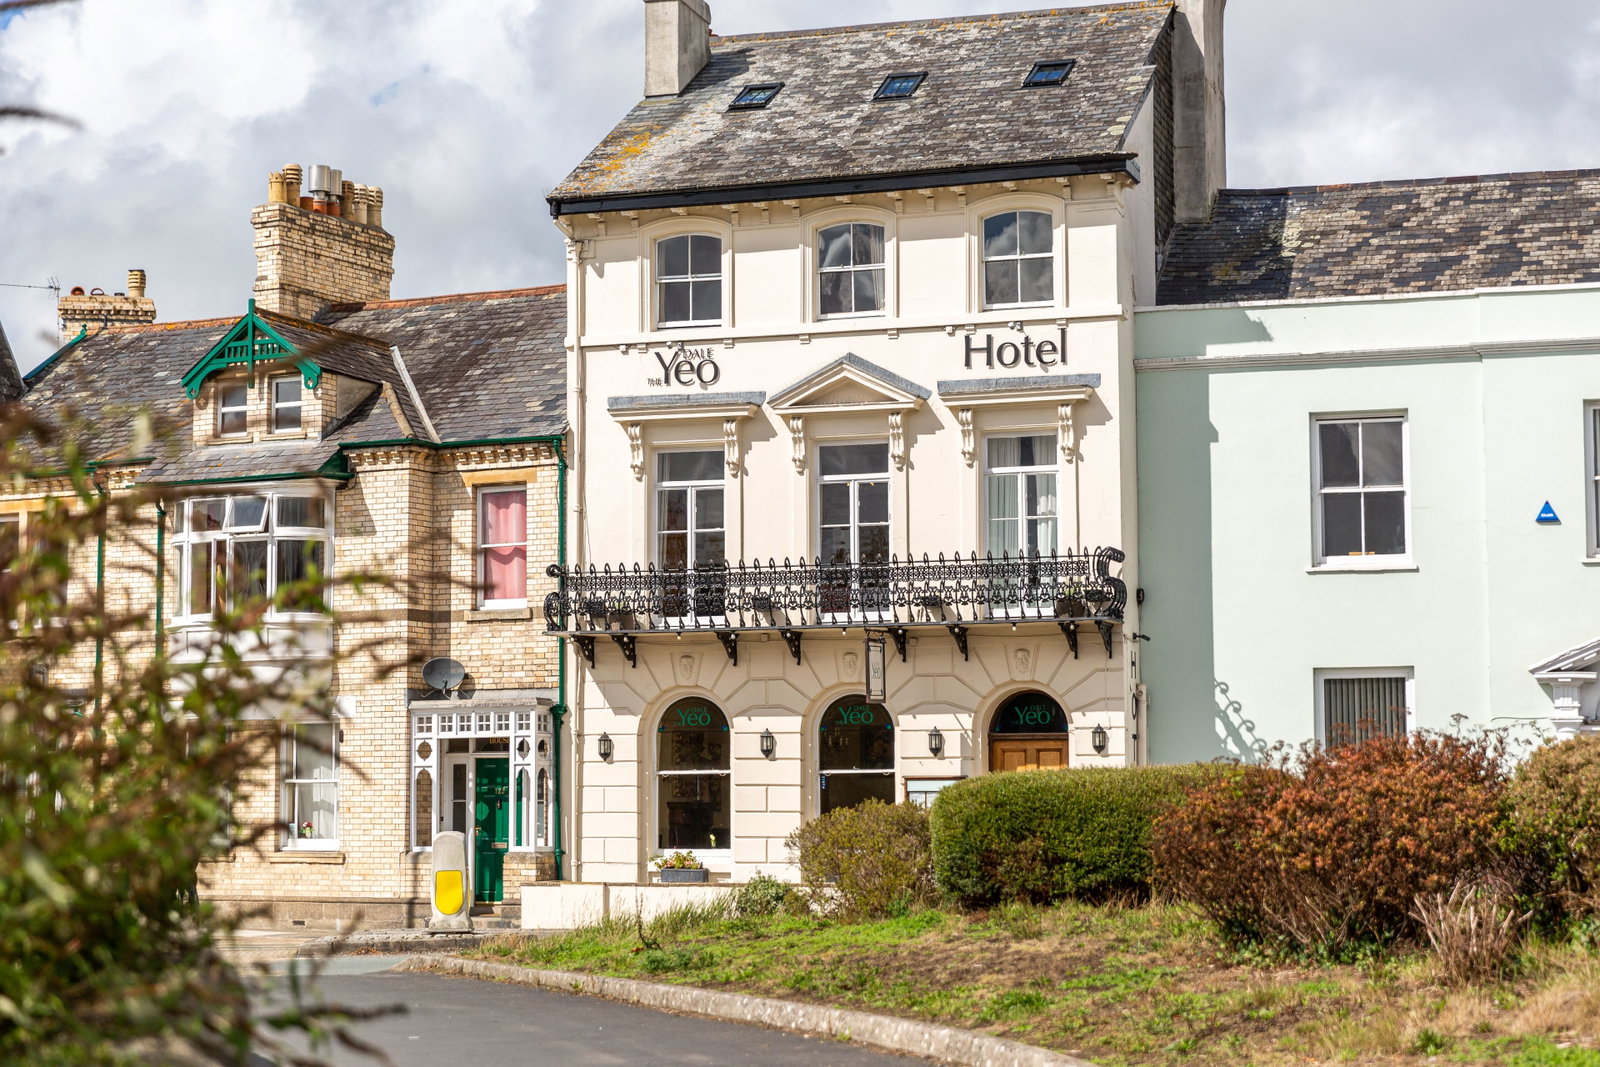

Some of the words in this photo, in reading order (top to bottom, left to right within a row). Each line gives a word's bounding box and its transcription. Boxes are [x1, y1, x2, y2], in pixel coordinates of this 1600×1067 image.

[683, 348, 714, 360] DALE
[964, 328, 1066, 367] Hotel
[654, 351, 719, 384] Yeo
[676, 708, 711, 726] Yeo
[838, 706, 874, 724] Yeo
[1014, 706, 1051, 725] Yeo
